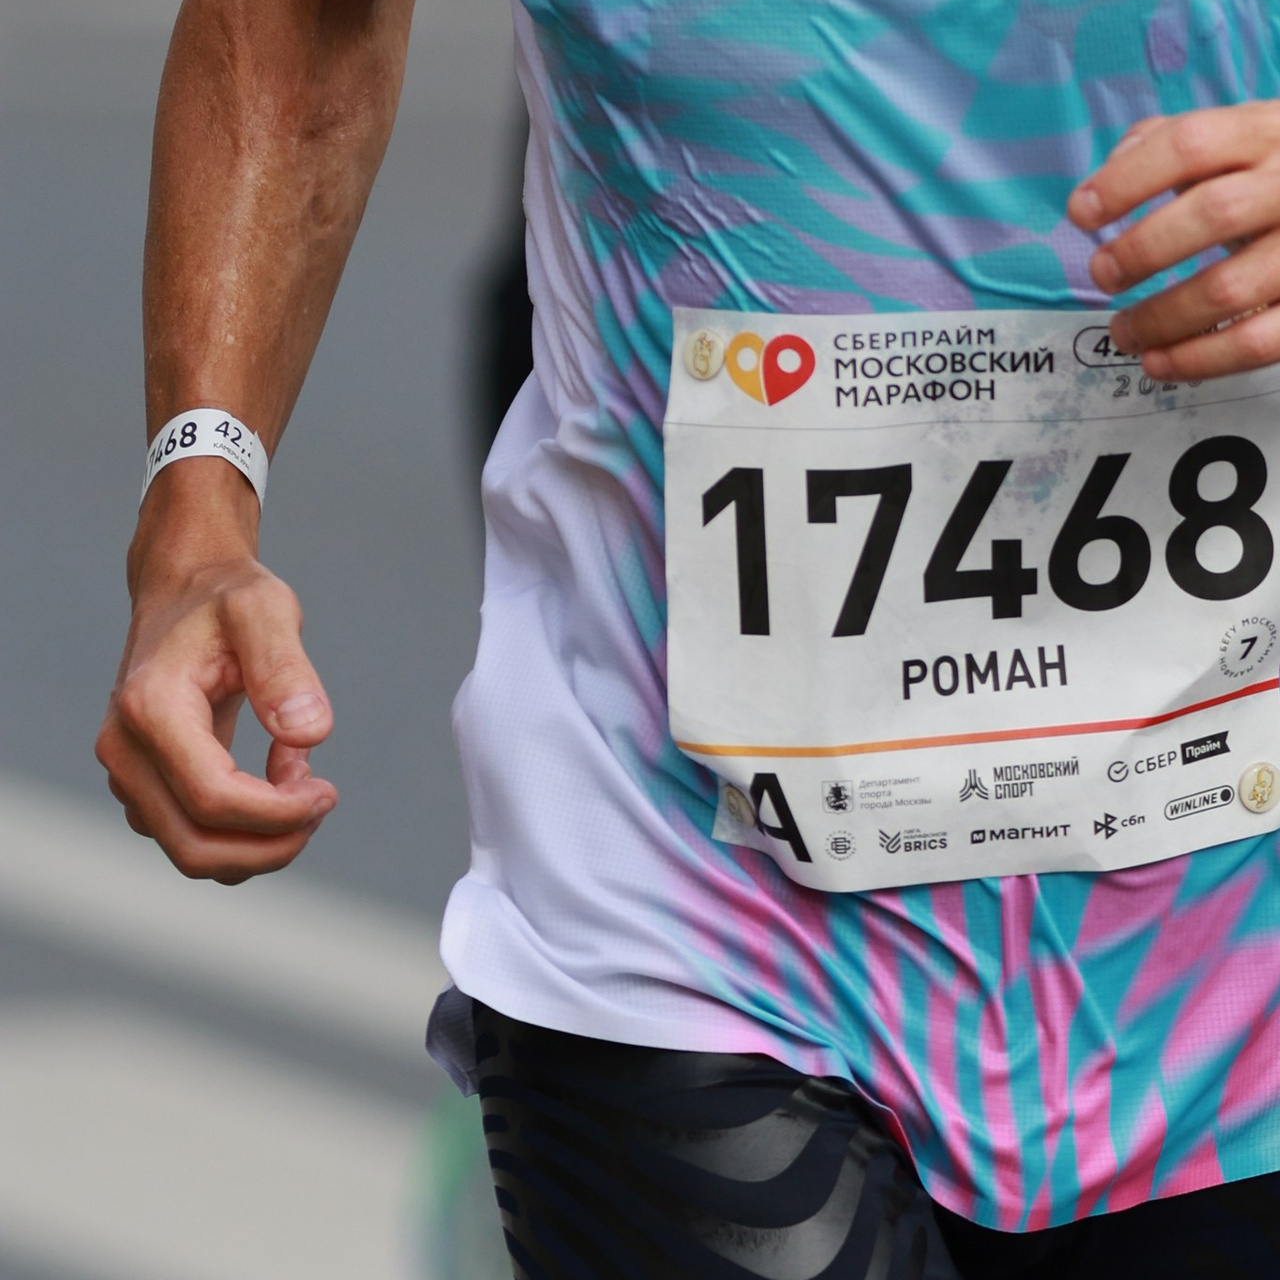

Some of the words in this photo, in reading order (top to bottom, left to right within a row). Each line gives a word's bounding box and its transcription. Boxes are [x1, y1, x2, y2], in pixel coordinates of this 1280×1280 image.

[833, 325, 996, 351] СБЕРПРАЙМ
[834, 347, 1055, 380] МОСКОВСКИЙ
[835, 378, 996, 408] МАРАФОН
[702, 434, 1274, 638] 17468
[1239, 635, 1258, 661] 7
[902, 644, 1068, 701] РОМАН
[993, 756, 1080, 783] МОСКОВСКИЙ
[1134, 750, 1177, 774] СБЕР
[1185, 741, 1221, 759] Прайм
[859, 776, 921, 789] Департамент
[860, 789, 892, 799] спорта
[995, 781, 1034, 800] СПОРТ
[860, 801, 893, 810] города
[895, 797, 932, 807] Москвы
[1169, 792, 1218, 817] WINLINE
[749, 772, 813, 863] A
[1121, 815, 1146, 827] сбп
[904, 838, 948, 852] BRICS
